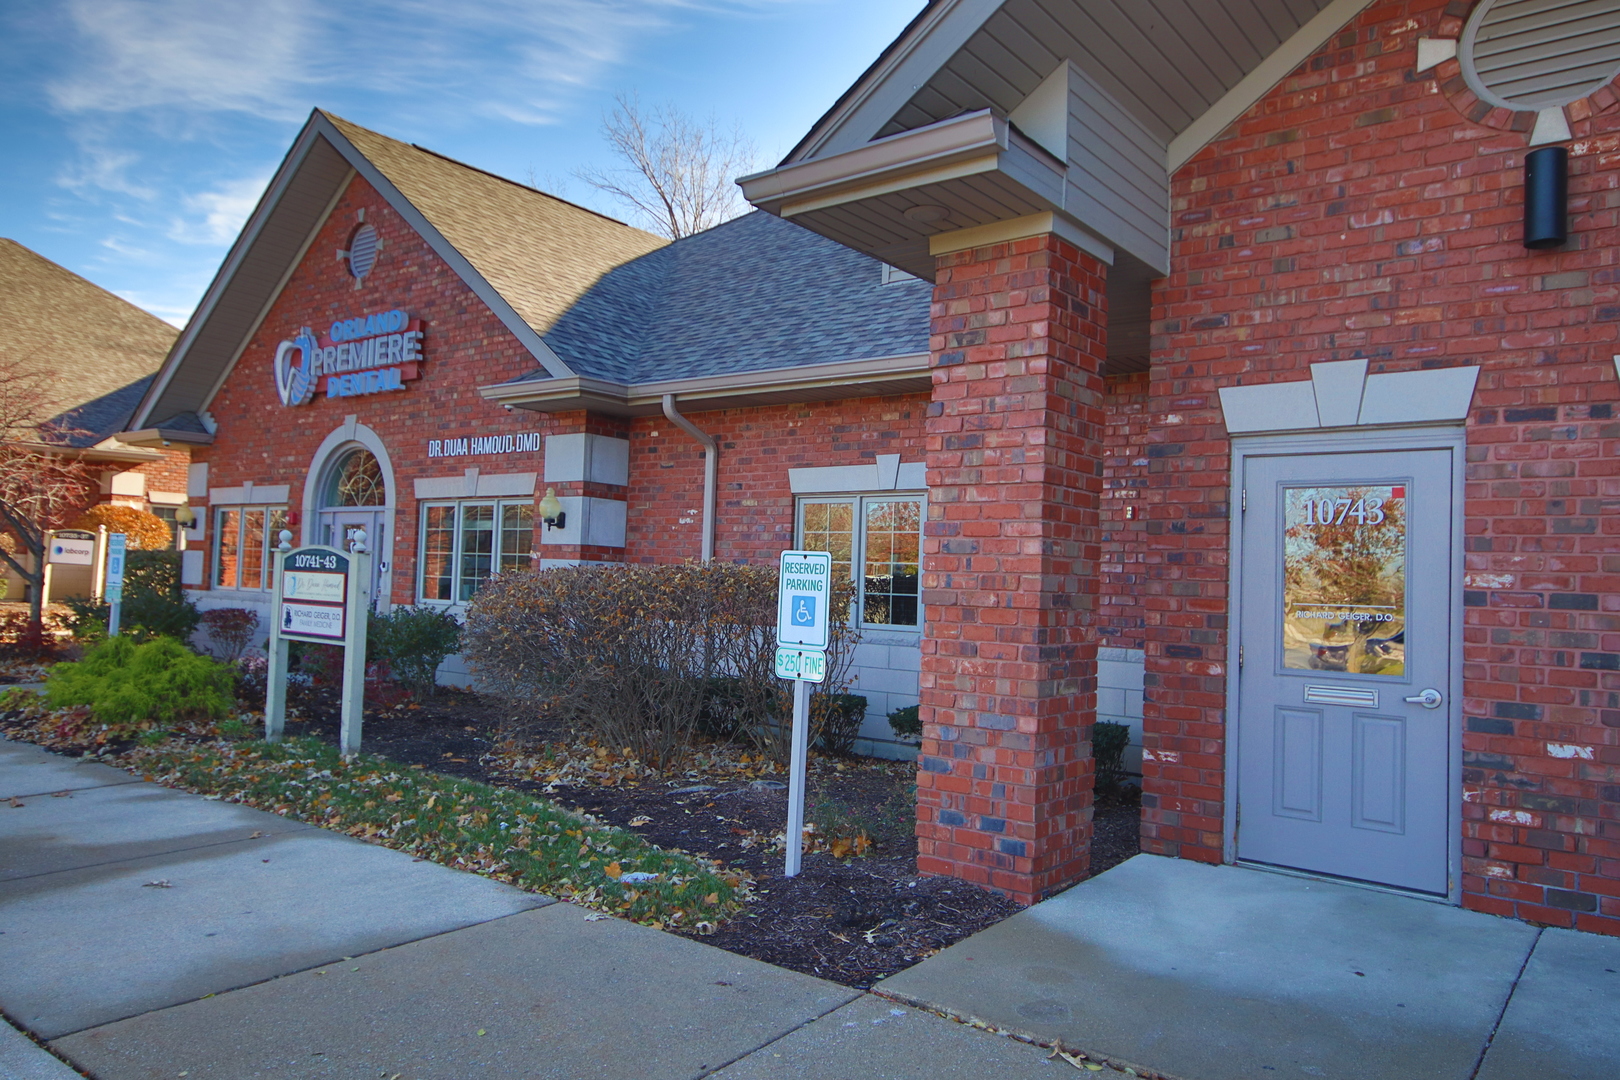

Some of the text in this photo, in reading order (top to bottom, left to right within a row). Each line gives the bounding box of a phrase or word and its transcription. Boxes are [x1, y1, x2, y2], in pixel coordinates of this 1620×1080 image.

[330, 309, 407, 342] ORLAND
[311, 331, 420, 376] PREMIERE
[327, 367, 403, 398] DENTAL
[428, 433, 540, 457] DR. DUAA HAMOUD, DMD
[1304, 497, 1384, 525] 10743
[64, 547, 90, 556] labcorp
[295, 554, 337, 569] 10741-43
[785, 562, 825, 575] RESERVED
[786, 578, 823, 592] PARKING
[294, 609, 313, 618] RICHARD
[1296, 610, 1395, 622] RICHARD GEIGER, D.O.
[313, 620, 333, 629] MEDICINE
[778, 654, 823, 675] $250 FINE
